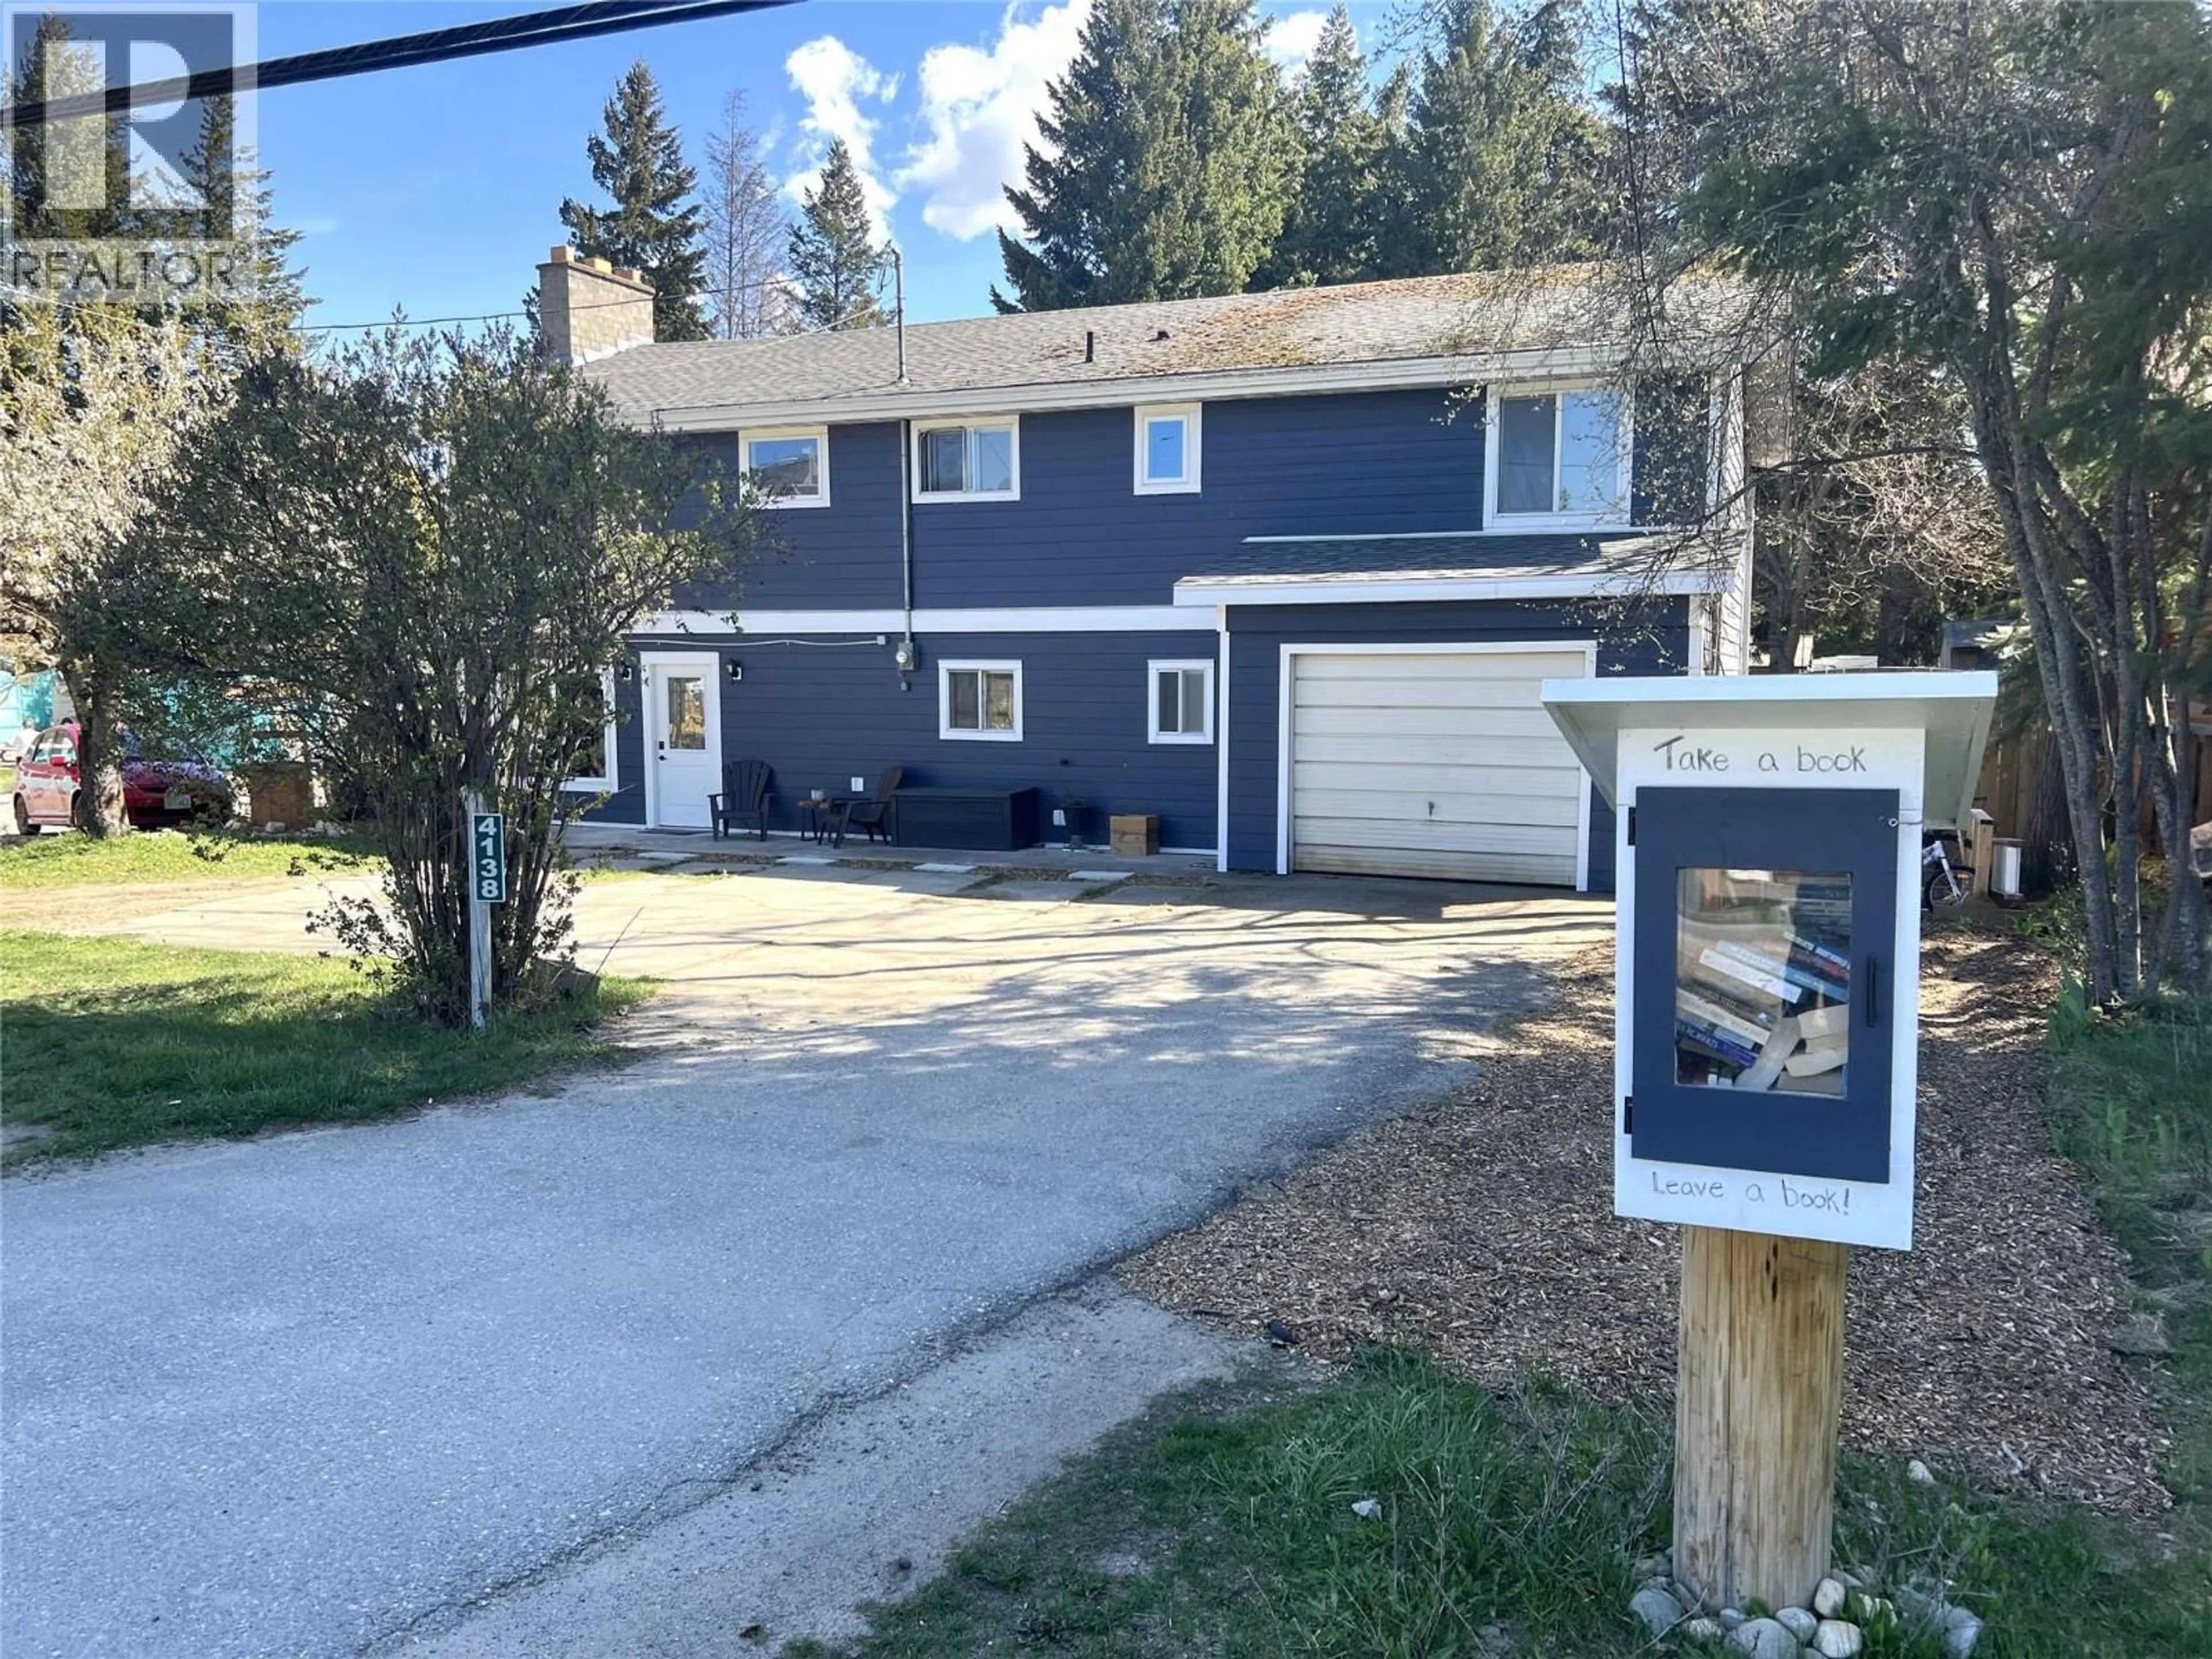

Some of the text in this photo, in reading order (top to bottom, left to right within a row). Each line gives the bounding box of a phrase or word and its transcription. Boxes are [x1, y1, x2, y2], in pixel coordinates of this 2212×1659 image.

[1653, 735, 1867, 772] Take a book
[478, 817, 498, 897] 4138
[1651, 1172, 1850, 1216] Leave a book!
